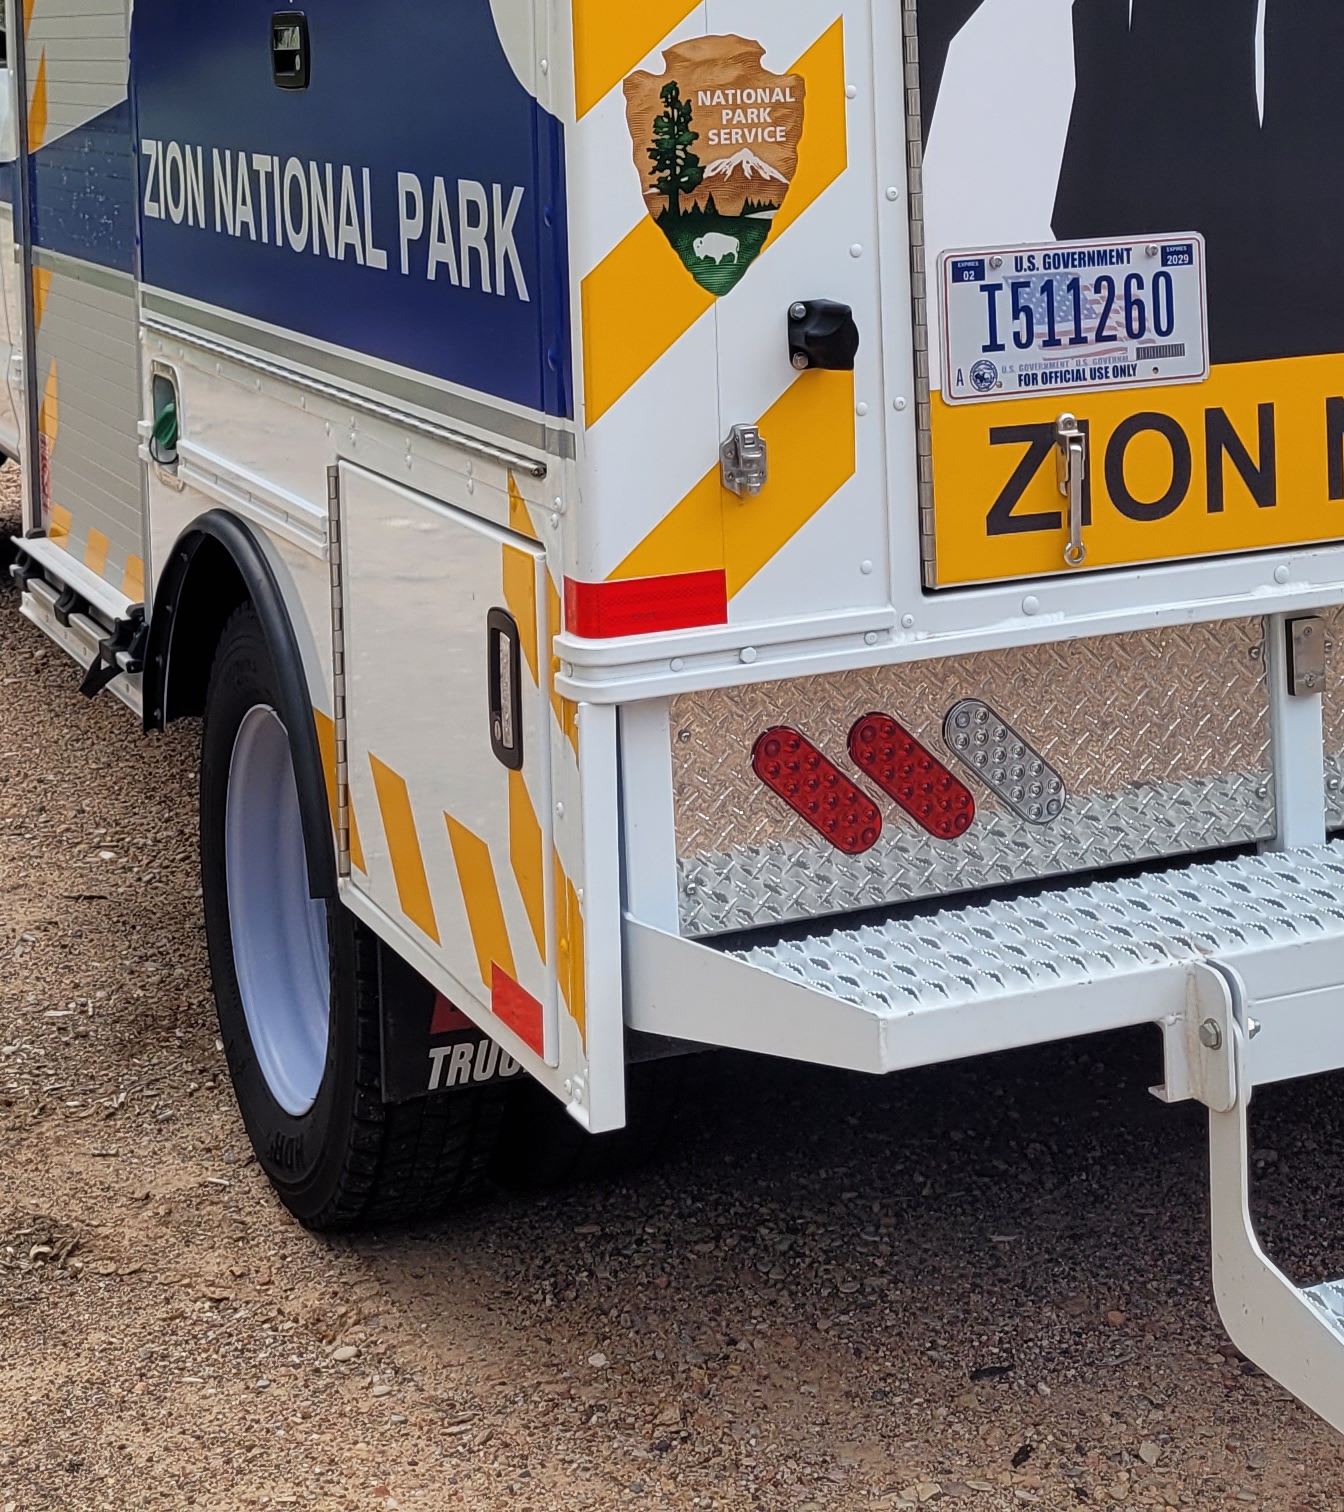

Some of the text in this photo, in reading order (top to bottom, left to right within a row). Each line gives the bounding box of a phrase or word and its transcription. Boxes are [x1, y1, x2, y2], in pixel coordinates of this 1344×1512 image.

[697, 87, 796, 106] NATIONAL
[721, 107, 773, 125] PARK
[707, 126, 787, 145] SERVICE
[141, 138, 531, 303] ZION NATIONAL PARK
[1014, 247, 1133, 273] U.S. GOVERNMENT
[1166, 254, 1189, 265] 2029
[963, 270, 975, 281] 02
[979, 270, 1175, 354] I511260
[956, 368, 965, 387] A
[1017, 372, 1039, 388] FOR
[1041, 367, 1088, 385] OFFICIAL
[1089, 365, 1110, 381] USE
[1112, 362, 1138, 379] ONLY
[986, 402, 1276, 537] ZION
